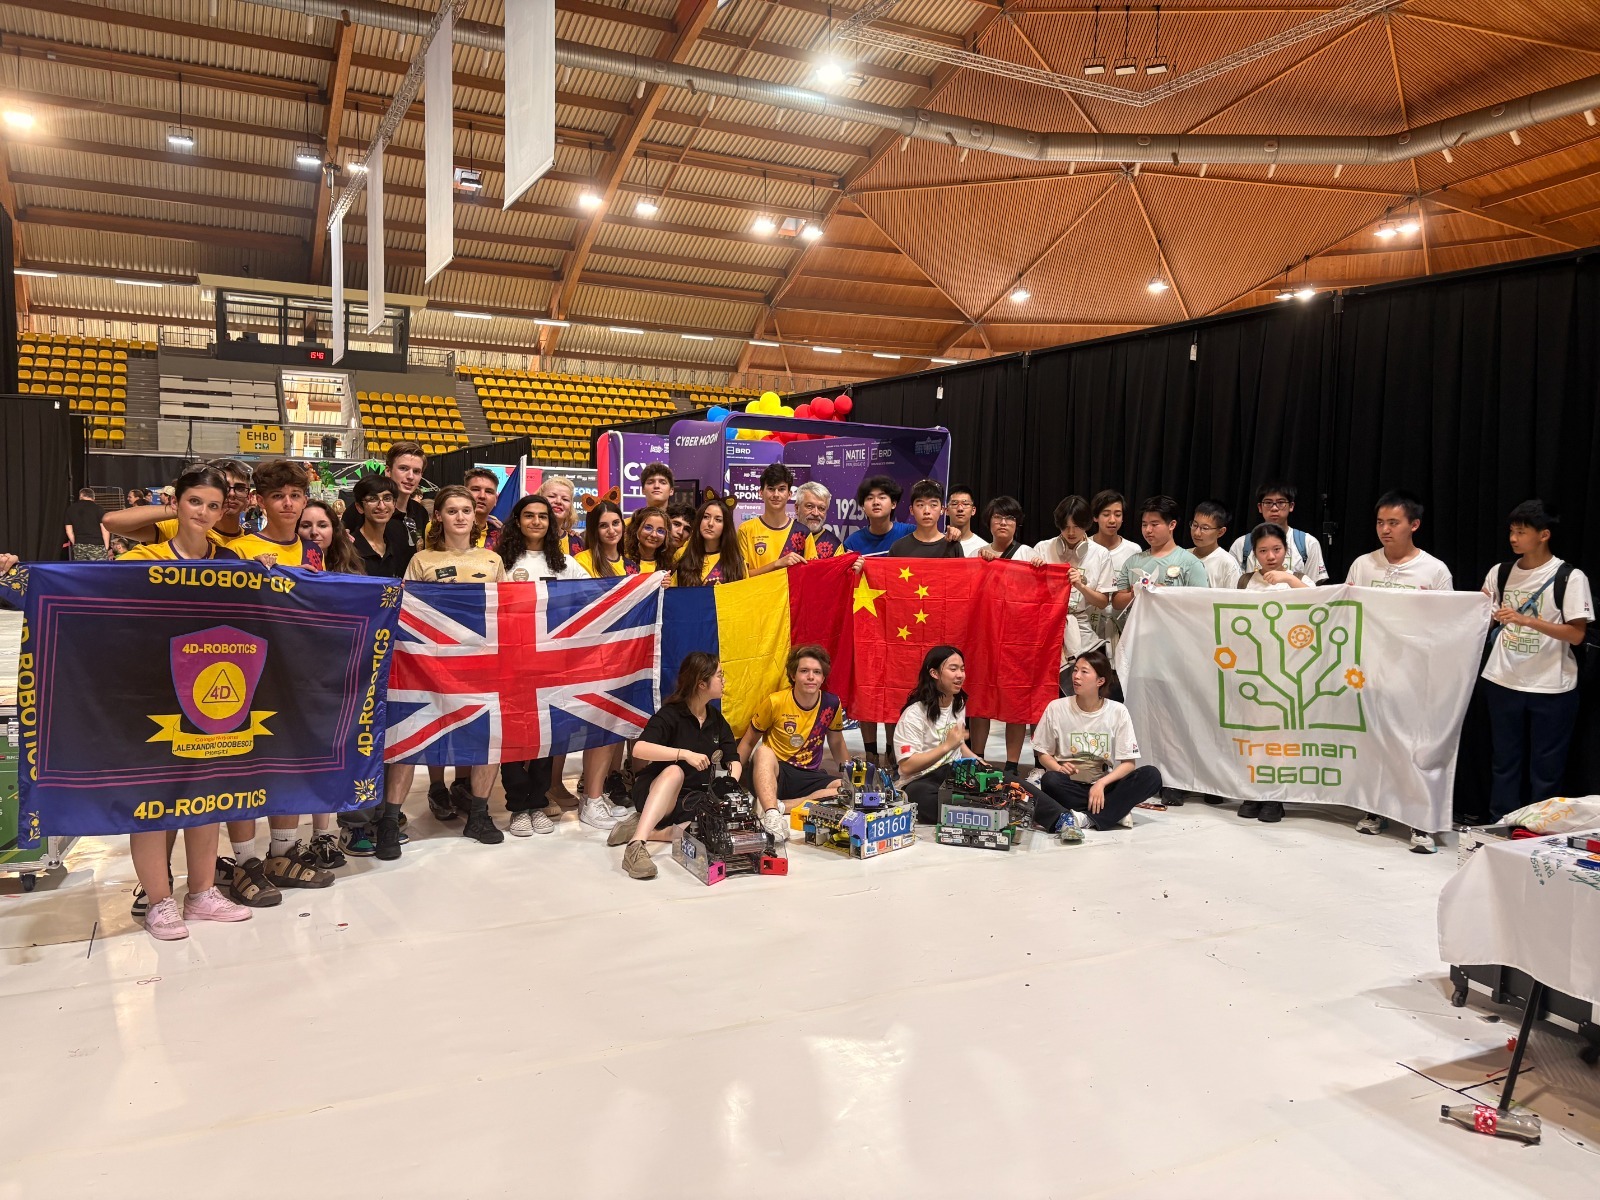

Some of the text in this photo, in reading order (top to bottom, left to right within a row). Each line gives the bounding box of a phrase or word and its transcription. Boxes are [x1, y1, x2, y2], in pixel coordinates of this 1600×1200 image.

[246, 431, 277, 441] EHBO
[675, 435, 698, 447] CYBER
[735, 447, 751, 455] BRD
[878, 448, 892, 458] BRD
[734, 483, 750, 491] This
[835, 498, 867, 521] 1925
[148, 565, 296, 594] 4D-ROBOTICS
[182, 643, 257, 654] 4D-ROBOTICS
[1502, 639, 1540, 654] 9600
[210, 685, 232, 700] 4D
[355, 627, 391, 758] 4D-ROBOTICS
[1231, 737, 1357, 760] Treeman
[1246, 764, 1342, 787] 19600
[133, 788, 267, 821] 4D-ROBOTICS
[871, 815, 907, 838] 18160
[947, 811, 989, 827] 19600
